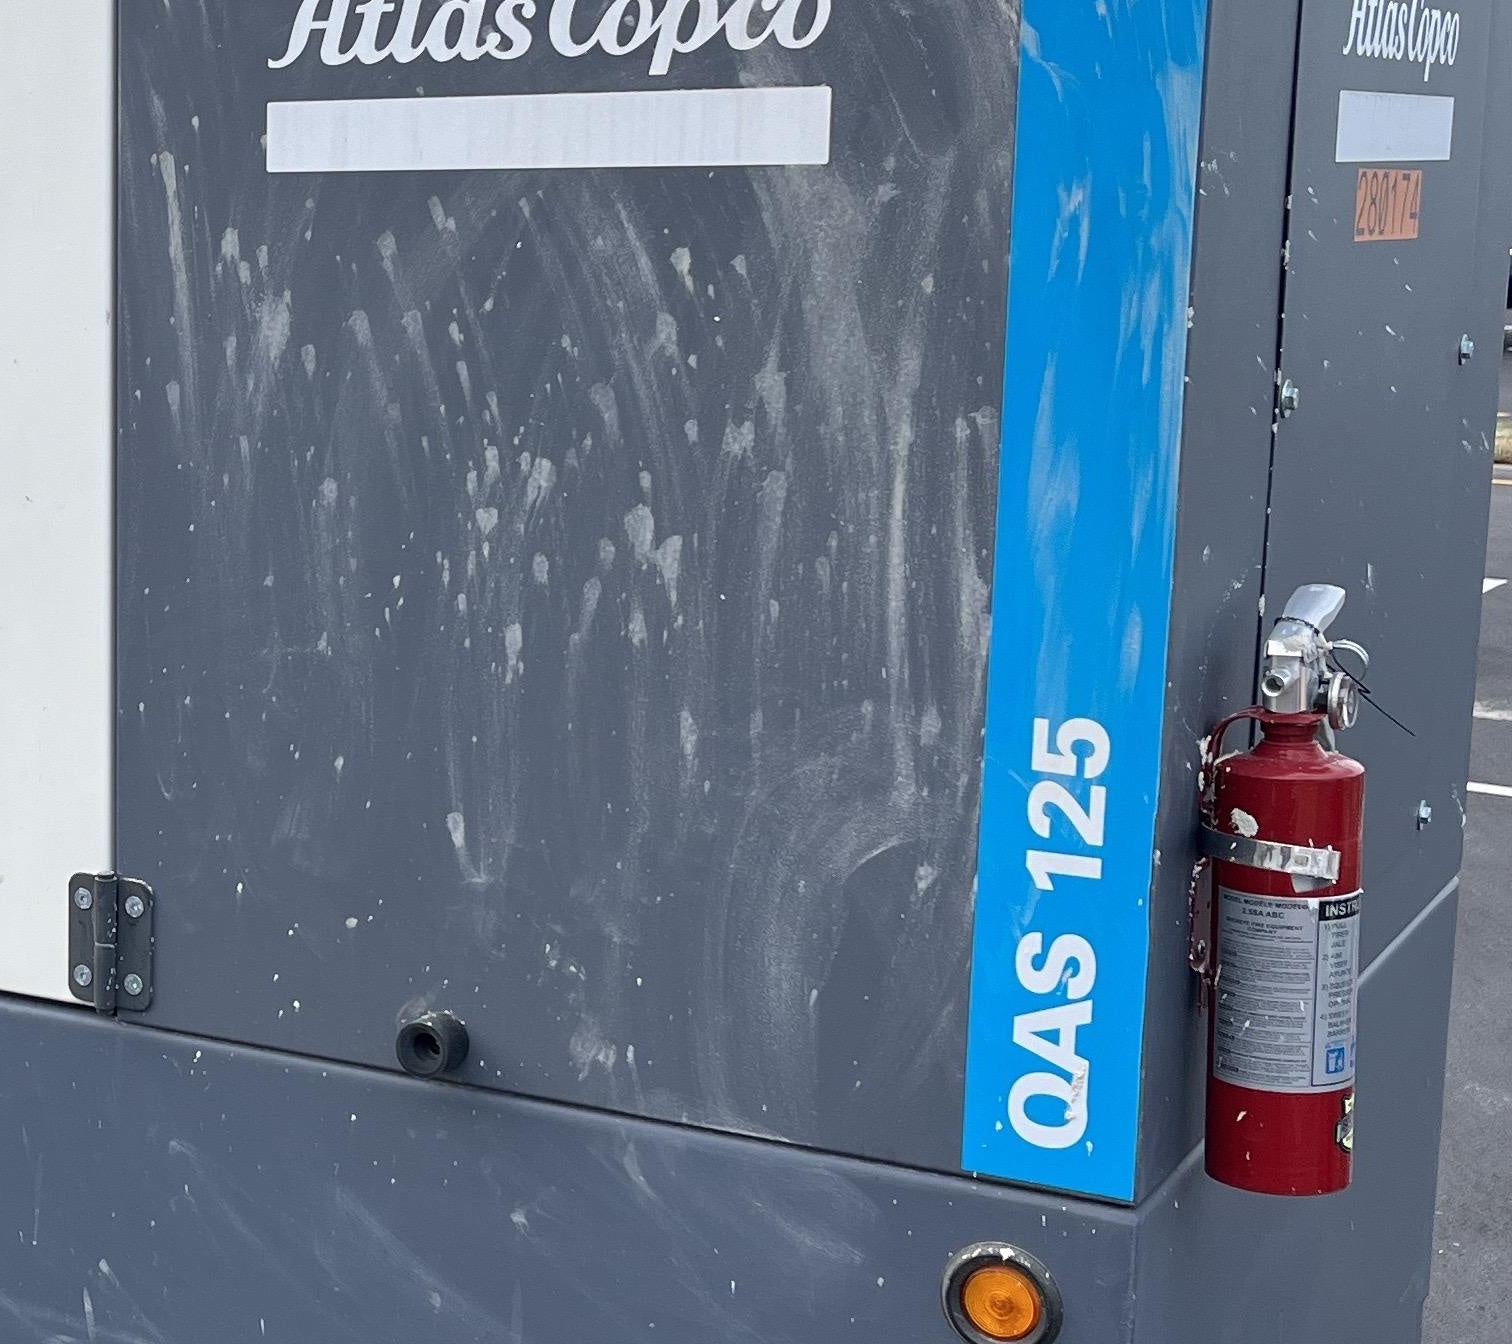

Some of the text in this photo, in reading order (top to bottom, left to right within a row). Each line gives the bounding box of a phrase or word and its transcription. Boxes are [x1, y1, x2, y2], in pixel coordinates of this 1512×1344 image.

[1356, 170, 1420, 236] 280174
[1006, 716, 1113, 1150] QAS 125
